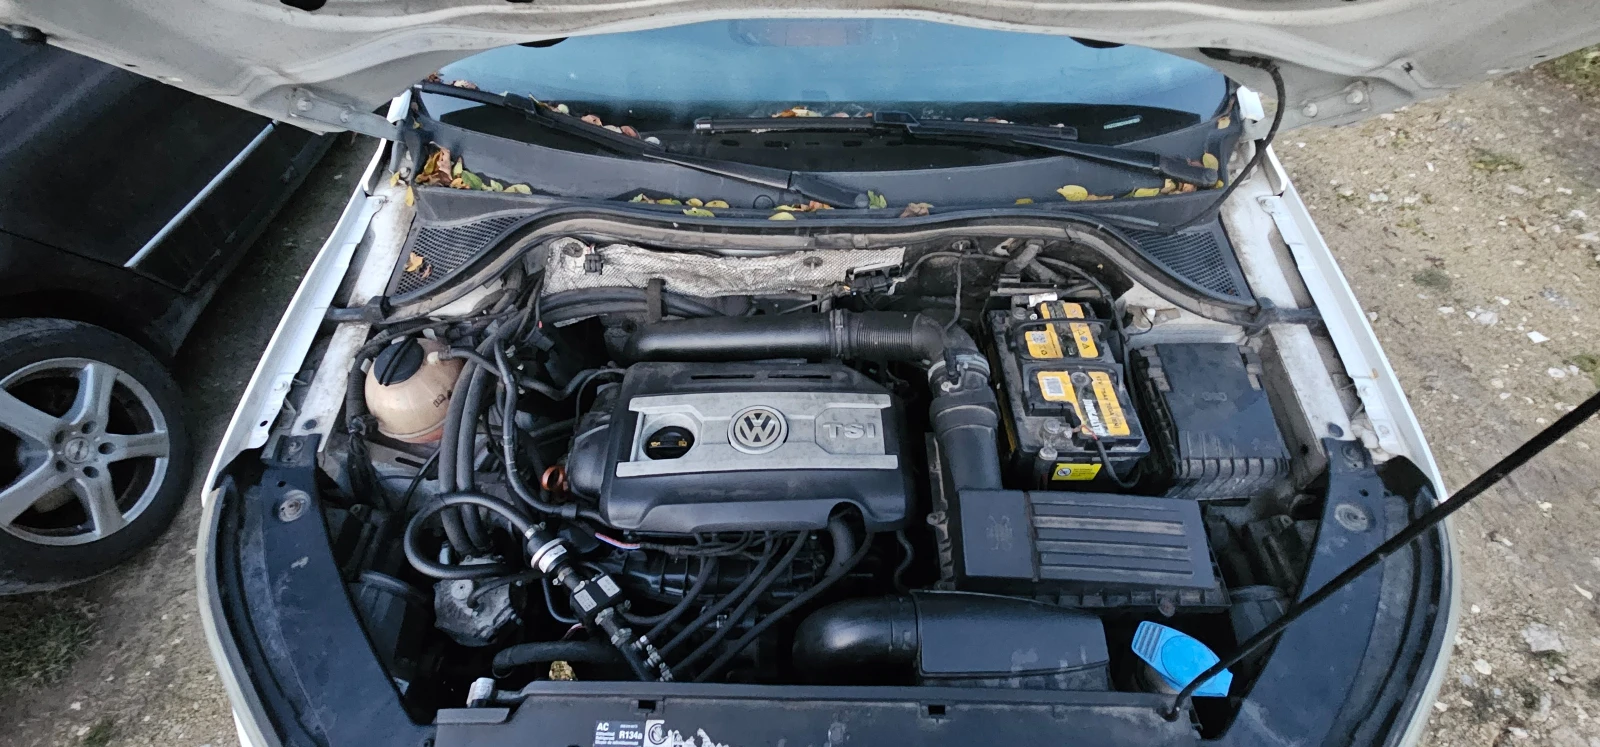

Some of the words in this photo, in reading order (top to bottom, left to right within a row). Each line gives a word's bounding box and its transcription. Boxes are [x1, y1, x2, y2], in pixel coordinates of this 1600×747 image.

[732, 407, 784, 449] VW
[822, 422, 876, 439] TSI
[597, 723, 609, 731] AC
[619, 731, 643, 739] R134a
